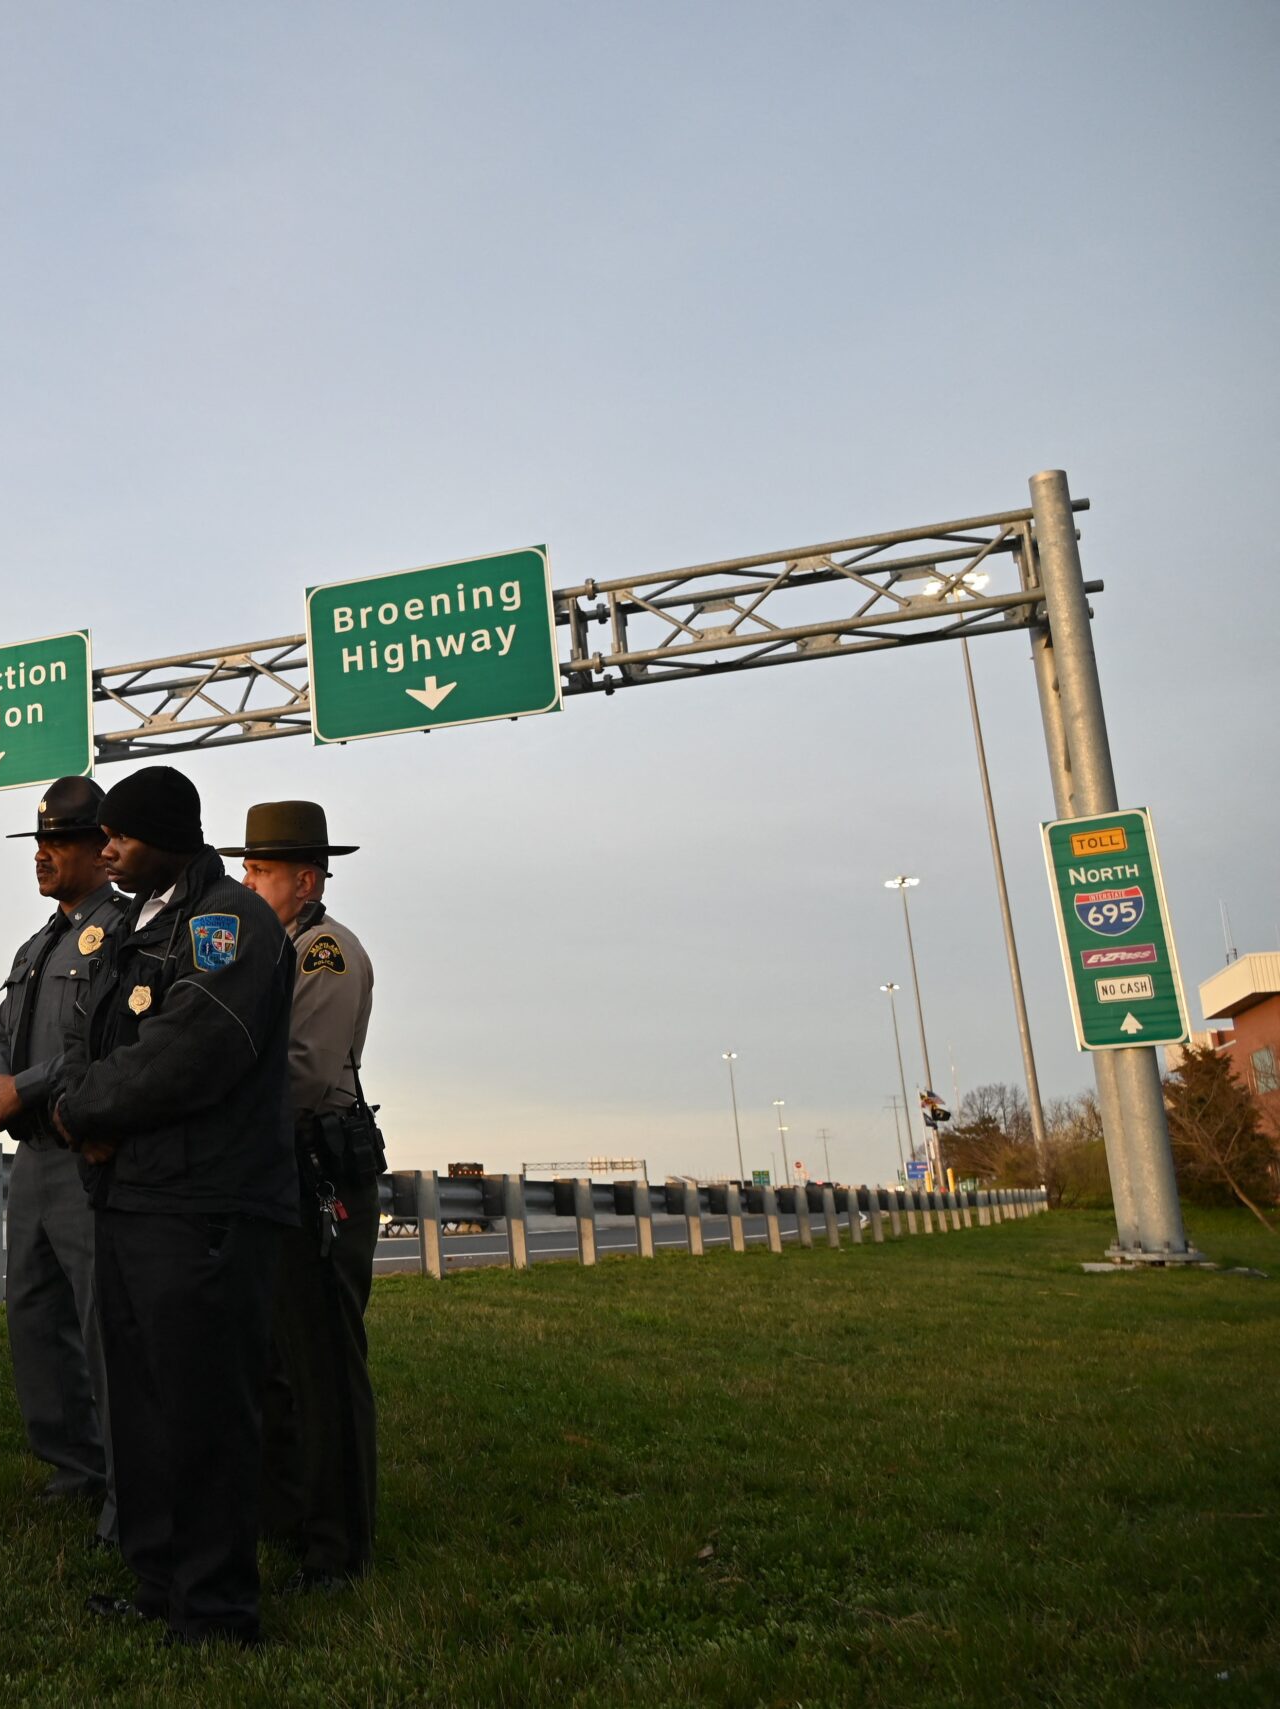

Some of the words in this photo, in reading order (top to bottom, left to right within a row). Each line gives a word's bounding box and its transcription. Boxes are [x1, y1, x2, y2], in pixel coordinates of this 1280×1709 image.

[333, 580, 522, 634] Broening
[342, 624, 517, 674] Highway
[1077, 835, 1120, 850] TOLL
[1069, 864, 1139, 885] NORTH
[1089, 890, 1125, 900] INTERSTATE
[1087, 901, 1137, 926] 695
[313, 960, 335, 968] POLICE
[1101, 984, 1116, 996] NO
[1120, 981, 1147, 994] CASH
